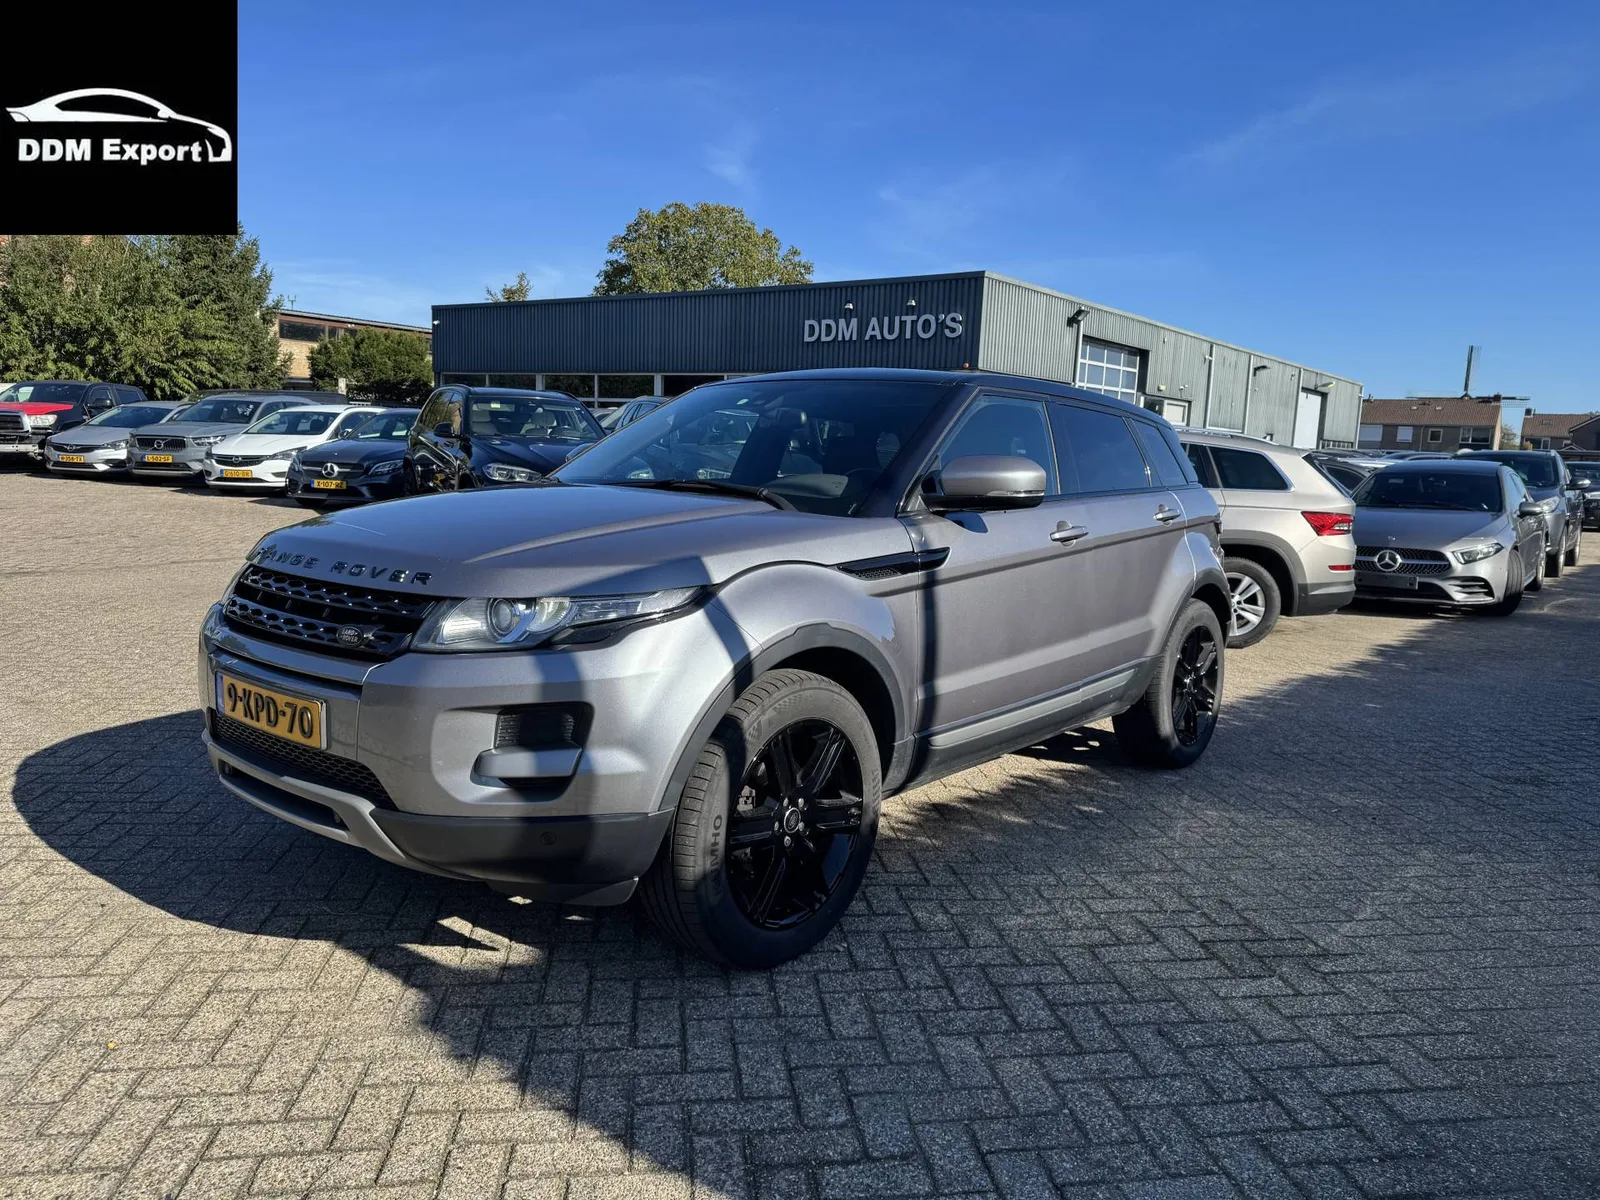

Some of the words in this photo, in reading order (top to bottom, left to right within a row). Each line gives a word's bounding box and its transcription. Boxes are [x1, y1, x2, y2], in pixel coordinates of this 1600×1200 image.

[803, 318, 857, 343] DDM
[864, 312, 963, 341] AUTO'S
[330, 561, 432, 586] ROVER
[227, 682, 314, 740] 9-KPD-70
